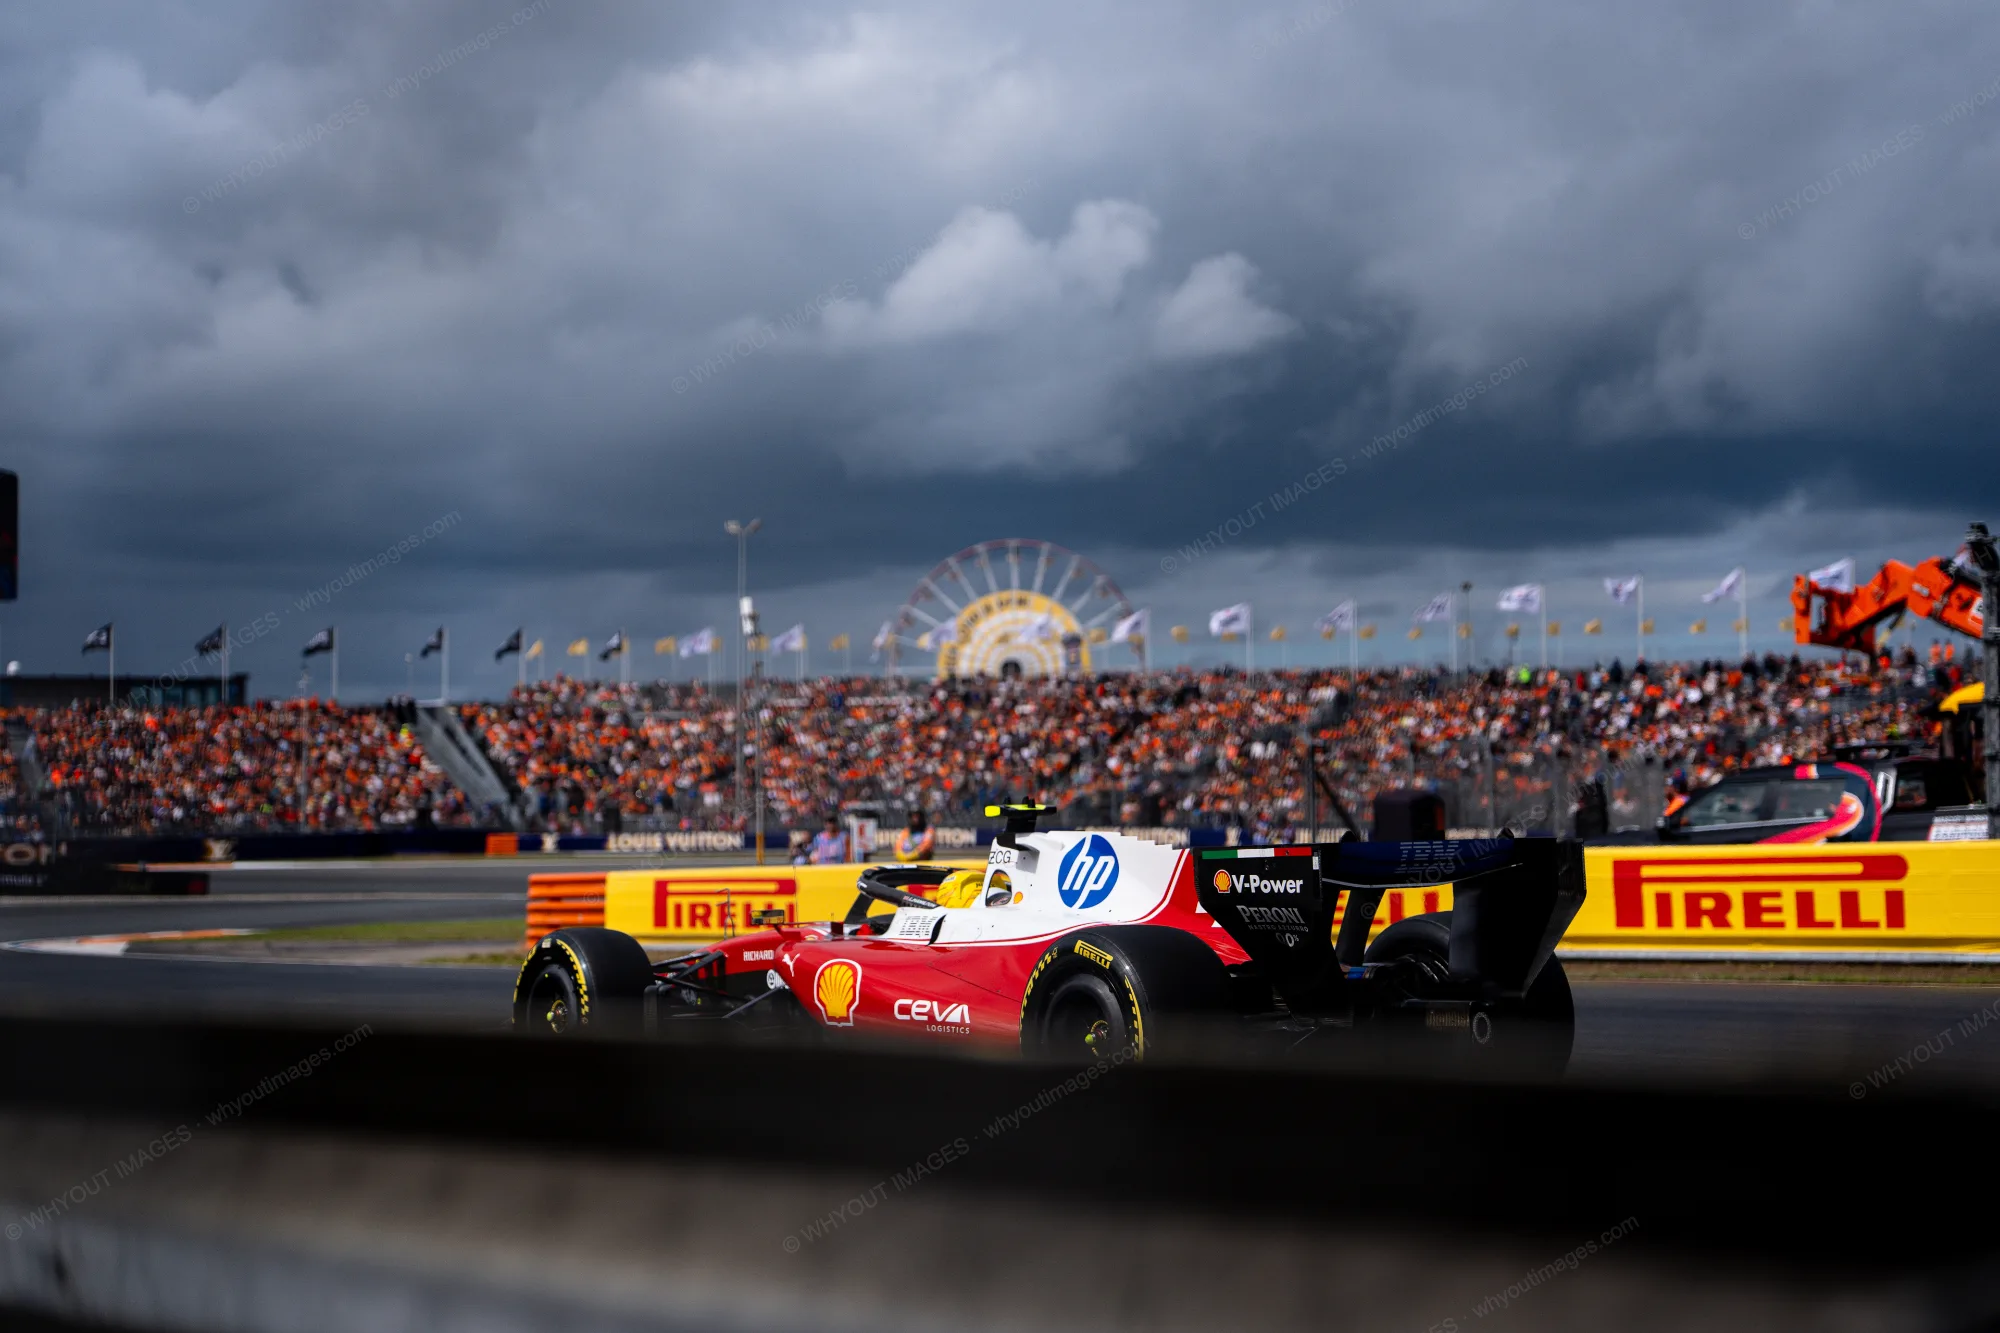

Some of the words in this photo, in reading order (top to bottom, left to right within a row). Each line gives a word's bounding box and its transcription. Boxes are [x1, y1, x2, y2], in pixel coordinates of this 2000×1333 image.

[1061, 834, 1116, 908] hp
[1232, 874, 1303, 894] V-Power
[1613, 854, 1908, 930] PIRELLI
[1236, 905, 1305, 924] PERONI
[1278, 924, 1308, 932] AZZURRO
[743, 949, 774, 961] RICHARD
[1074, 940, 1114, 970] PIRELLI
[926, 1024, 970, 1034] LOGISTICS
